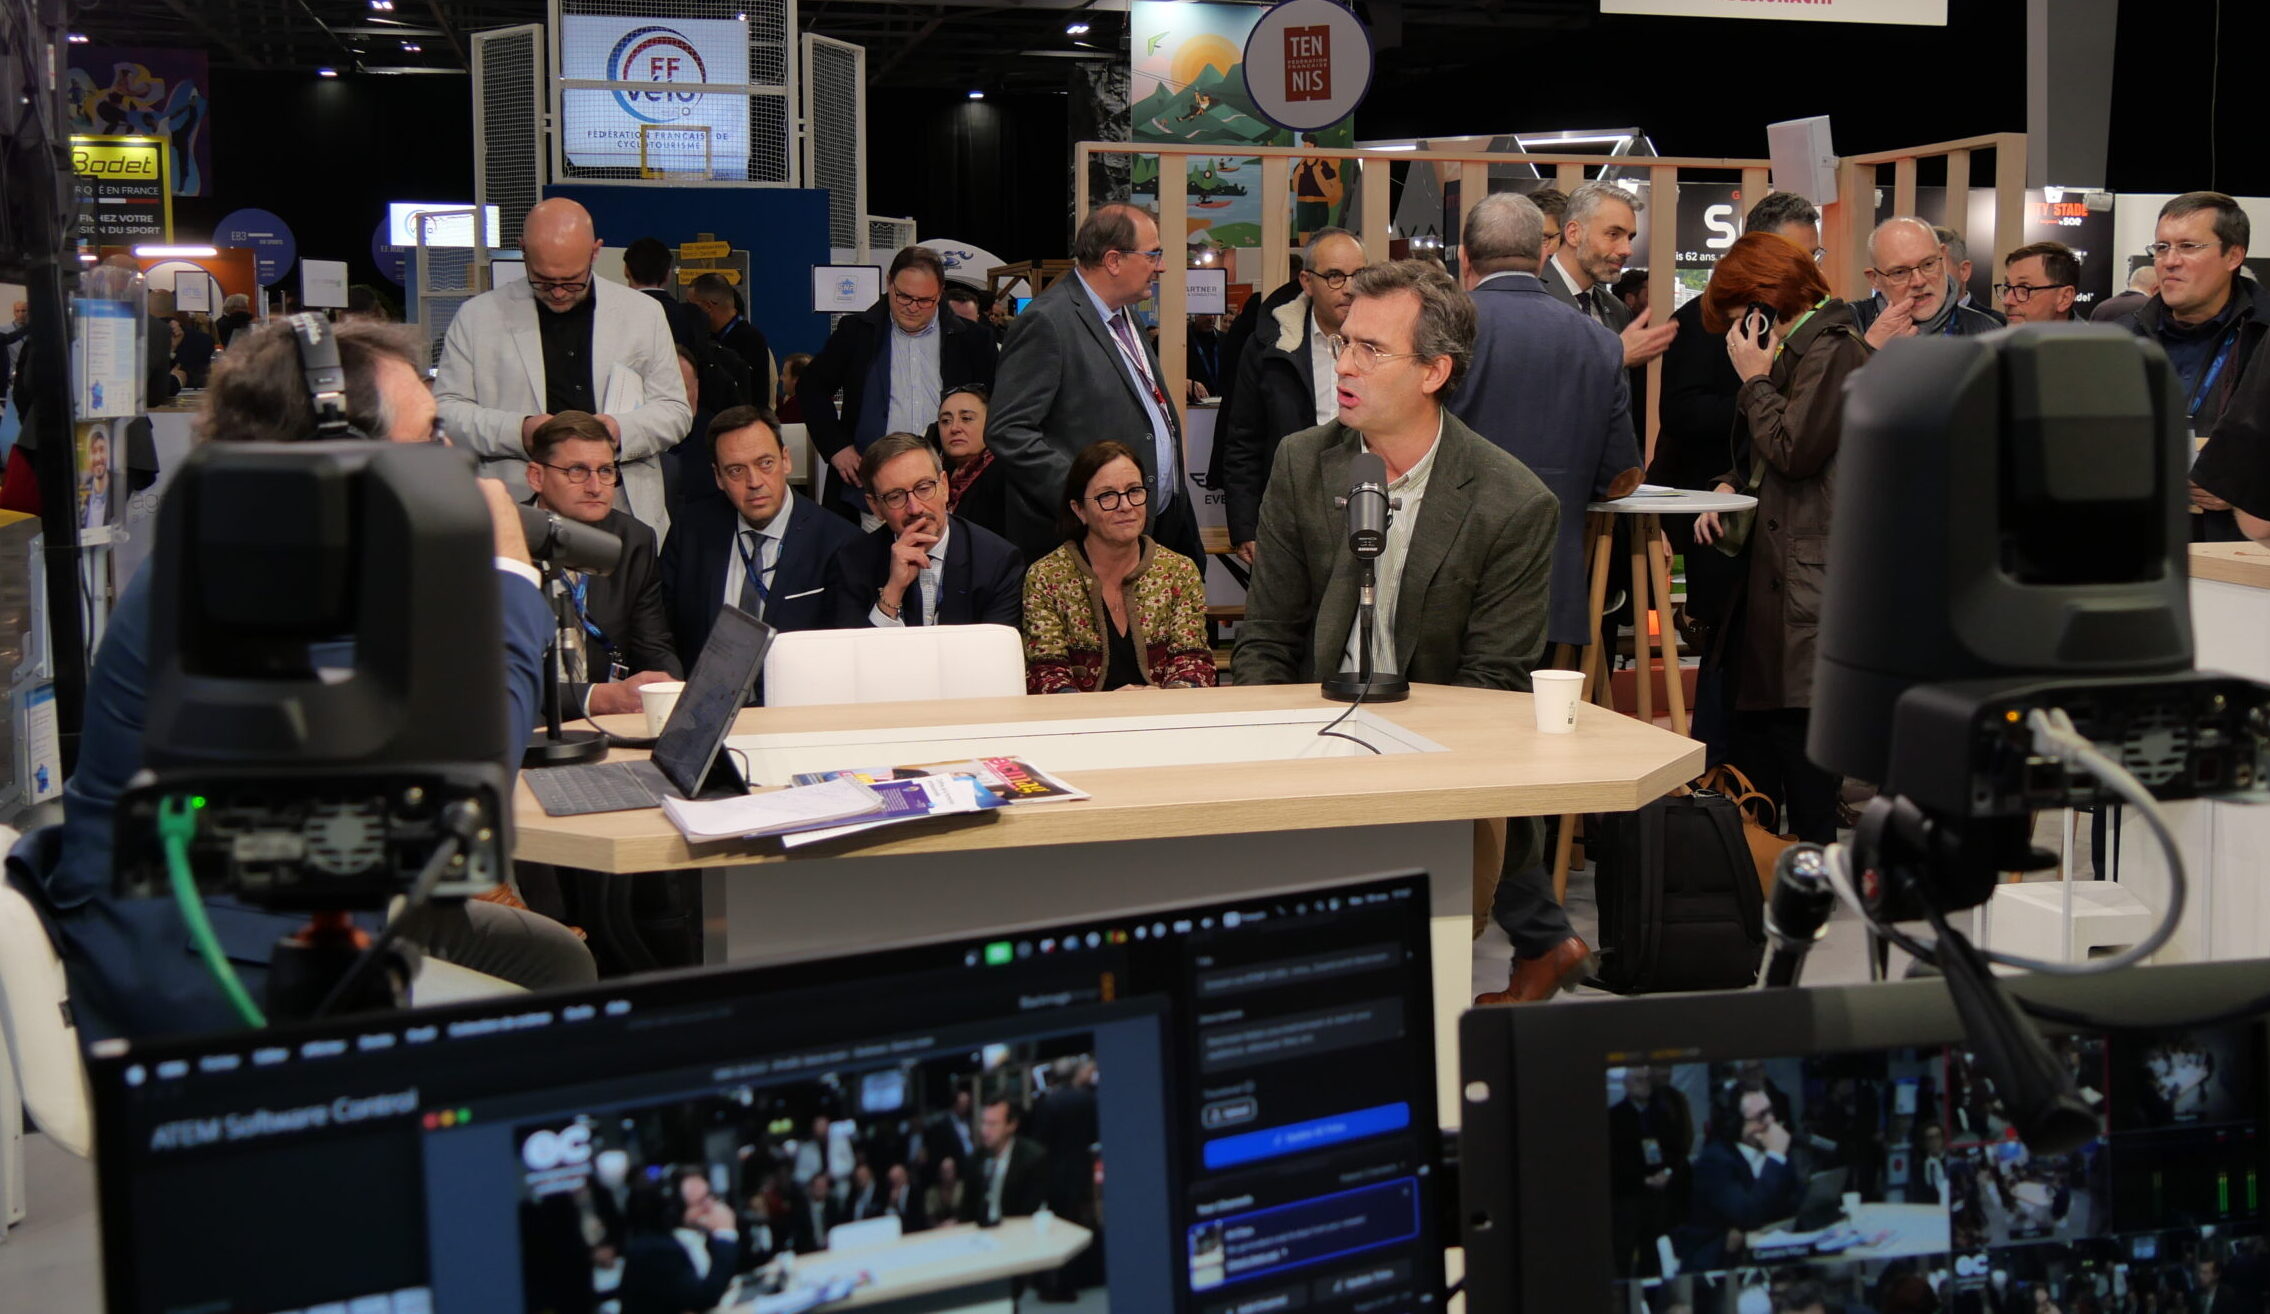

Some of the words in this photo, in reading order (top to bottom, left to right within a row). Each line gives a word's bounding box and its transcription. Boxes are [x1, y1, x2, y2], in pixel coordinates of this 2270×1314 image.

[1289, 35, 1323, 57] TEN
[650, 57, 681, 79] FF
[1292, 70, 1324, 92] NIS
[655, 131, 706, 141] FRANÇAIS
[716, 132, 729, 141] DE
[73, 151, 152, 174] Bodet
[106, 186, 120, 194] EN
[121, 186, 159, 195] FRANCE
[2053, 202, 2089, 217] STADE
[119, 214, 154, 223] VOTRE
[126, 227, 160, 235] SPORT
[1685, 251, 1698, 261] 62
